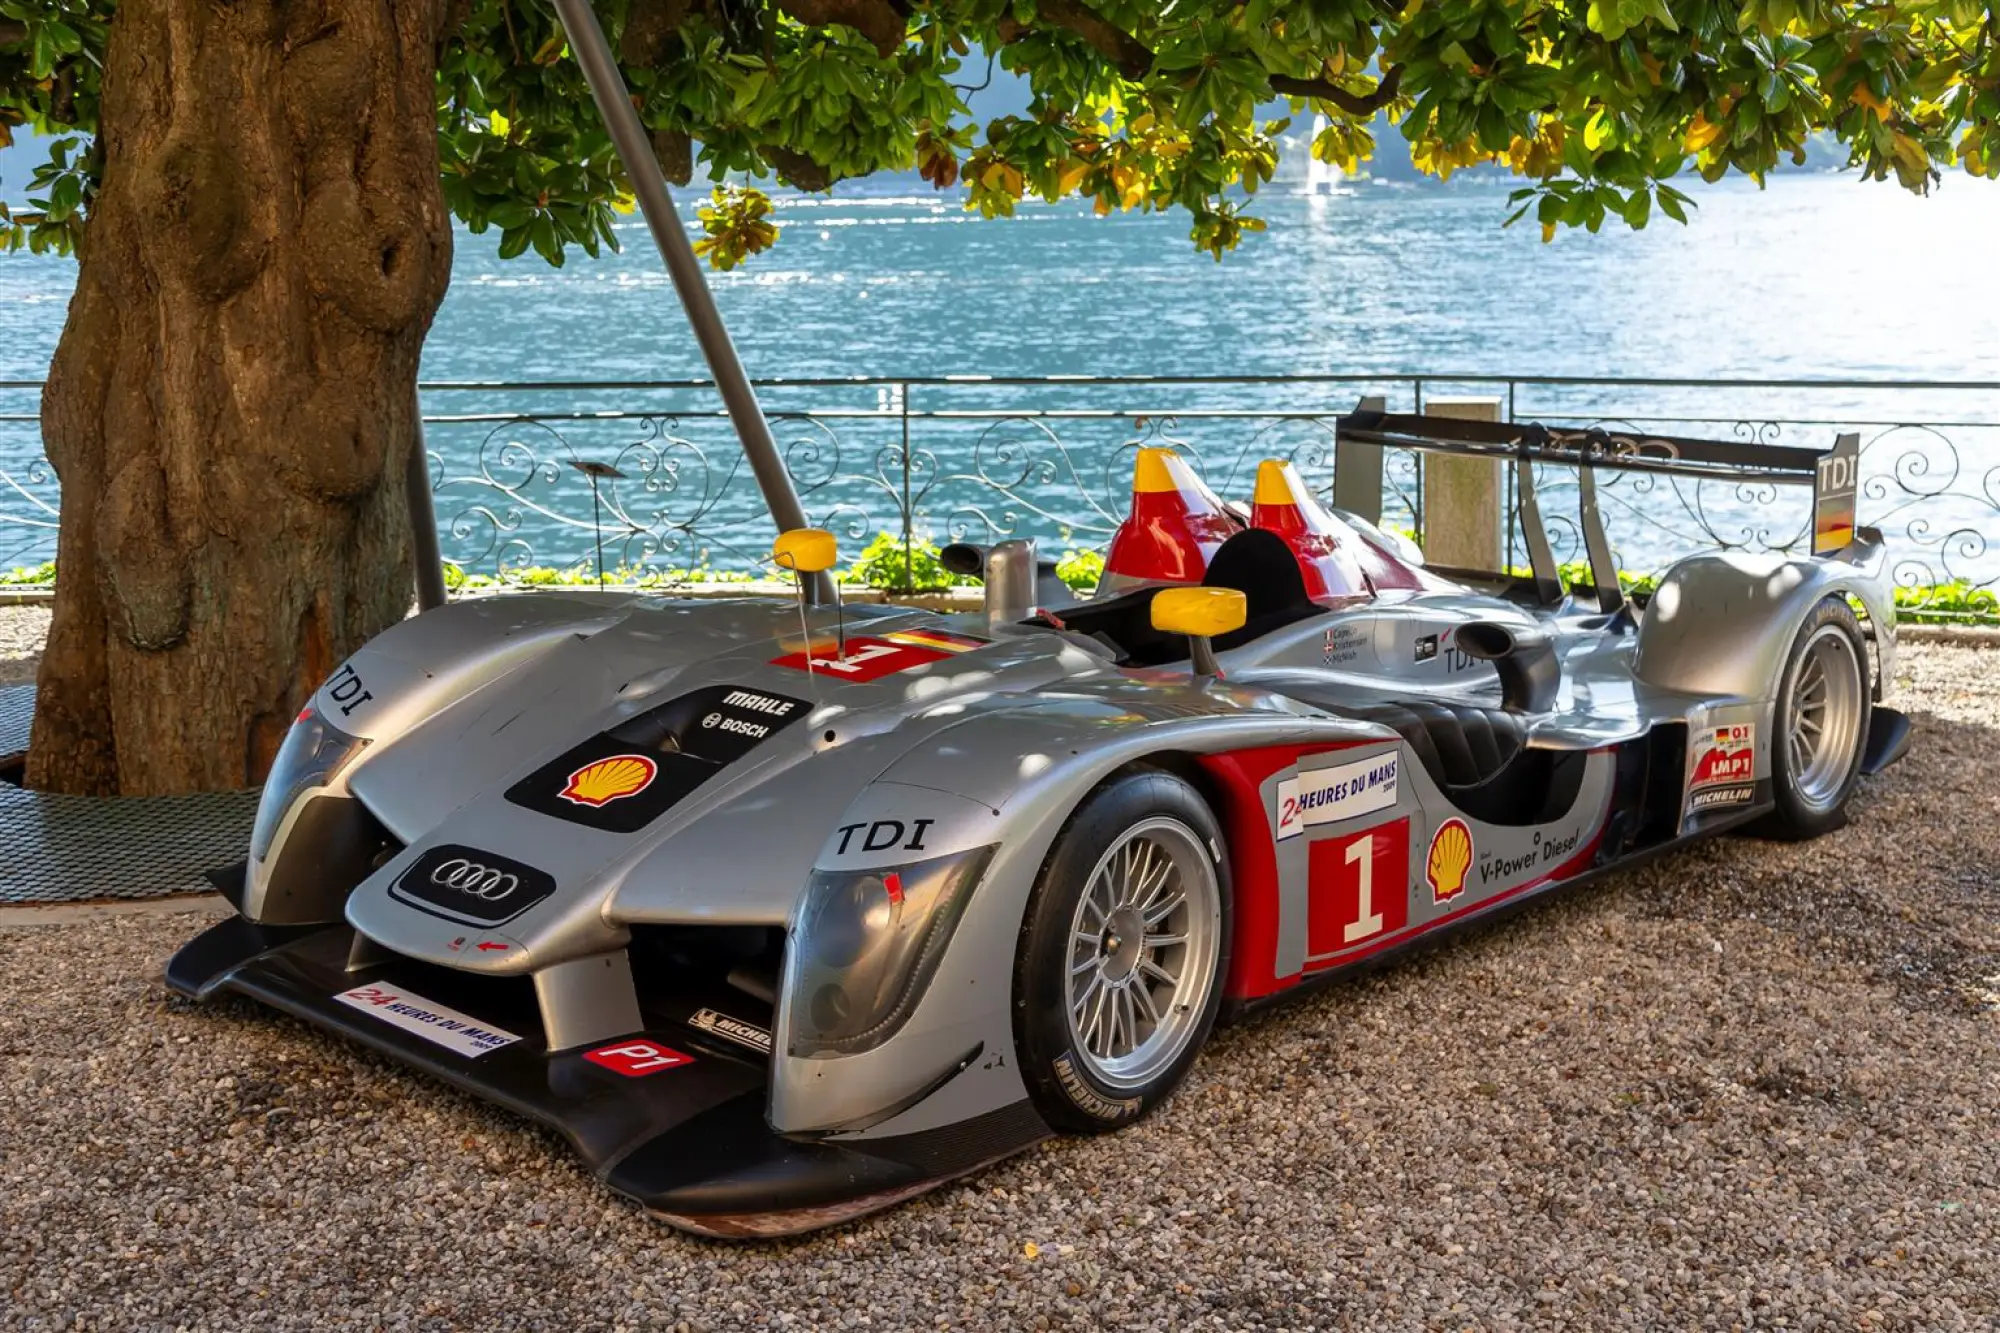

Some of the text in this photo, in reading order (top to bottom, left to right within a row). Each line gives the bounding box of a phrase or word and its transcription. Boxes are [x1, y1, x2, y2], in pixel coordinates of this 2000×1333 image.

[1818, 455, 1857, 492] TDI
[325, 664, 374, 716] TDI
[722, 691, 794, 716] MAHLE
[720, 718, 769, 738] BOSCH
[1732, 727, 1749, 739] 01
[1300, 782, 1348, 810] HEURES
[1350, 774, 1366, 796] DU
[1368, 760, 1396, 789] MANS
[1710, 758, 1750, 776] LMP1
[1693, 788, 1752, 806] MICHELIN
[837, 819, 935, 855] TDI
[1481, 826, 1580, 884] V-Power Diesel
[1344, 833, 1383, 943] 1
[345, 988, 512, 1045] 24 HEURES DU MANS
[717, 1018, 771, 1046] MICHEL
[597, 1044, 681, 1070] P1
[1056, 1059, 1123, 1119] MICHELIN
